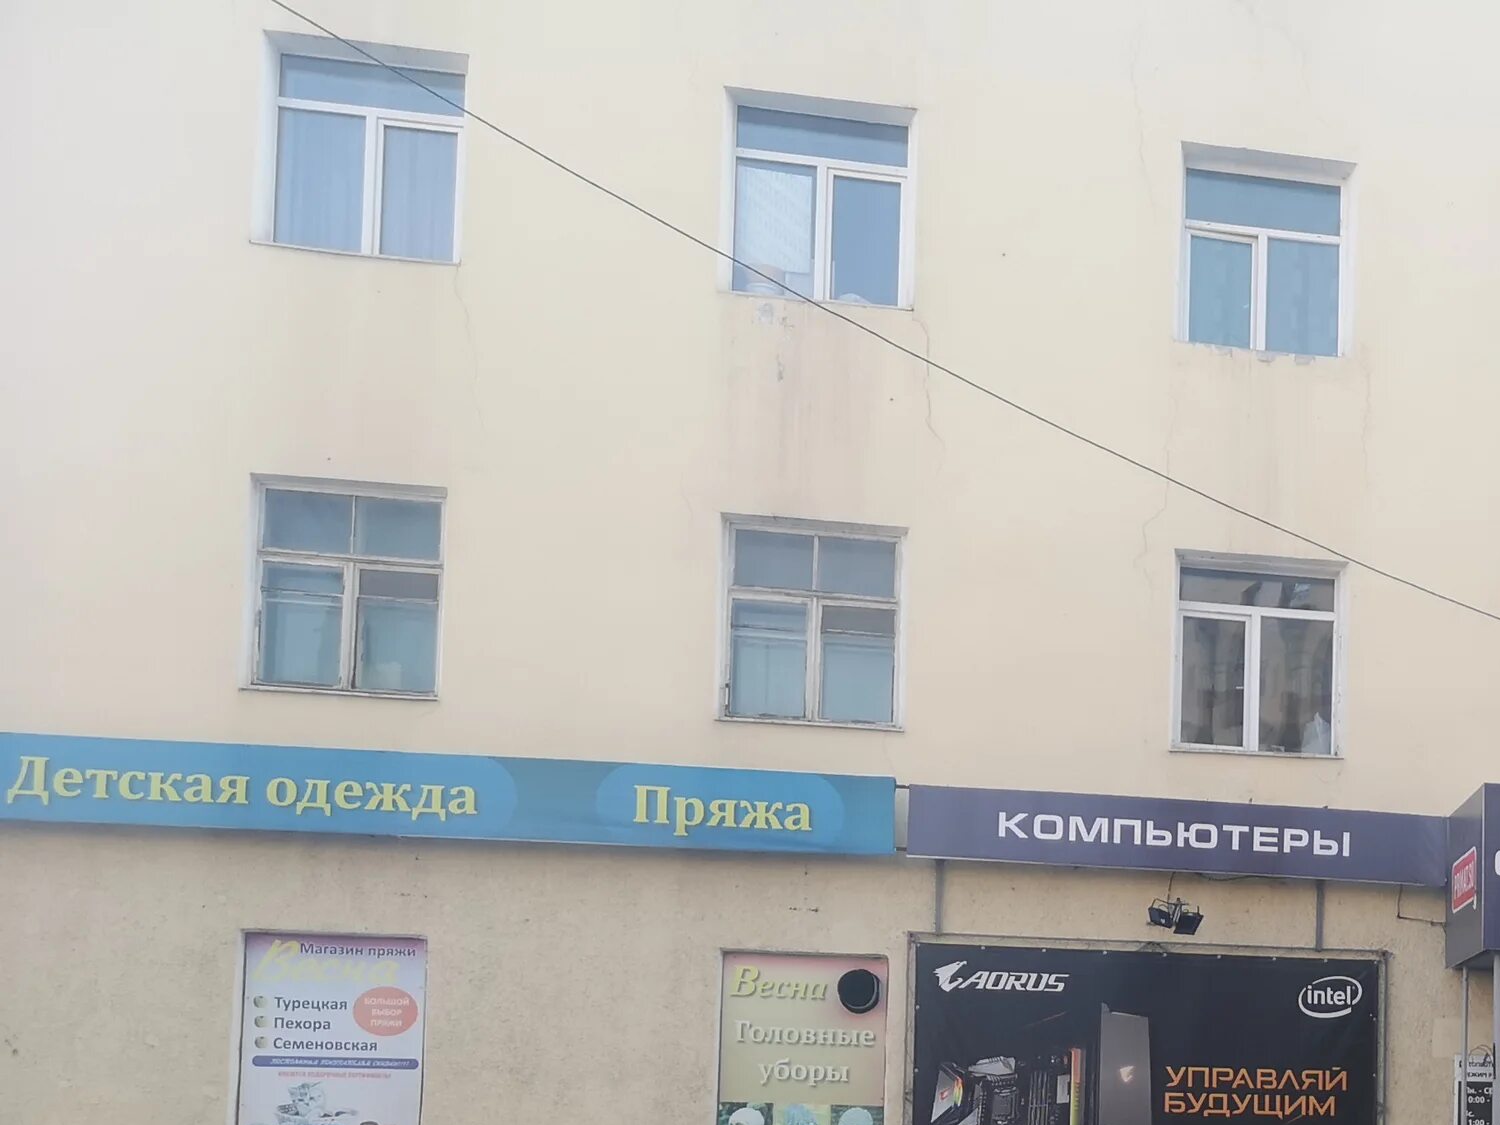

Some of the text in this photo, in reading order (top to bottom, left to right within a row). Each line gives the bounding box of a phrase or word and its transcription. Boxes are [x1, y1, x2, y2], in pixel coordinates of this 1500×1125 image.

[7, 755, 479, 822] Детская одежда
[633, 784, 813, 837] Пряжа
[998, 811, 1351, 858] КОМПЬЮТЕРЫ
[300, 942, 417, 959] Магазин пряжи
[730, 965, 829, 1000] Весна
[958, 970, 1070, 992] AORUS
[274, 996, 348, 1011] Турецкая
[1306, 984, 1352, 1006] intel
[273, 1016, 332, 1032] Пехора
[735, 1019, 876, 1048] Головные
[273, 1037, 378, 1052] Семеновская
[758, 1057, 850, 1087] уборы
[1165, 1066, 1349, 1091] УПРАВЛЯЙ
[1164, 1092, 1336, 1120] БУДУЩИМ
